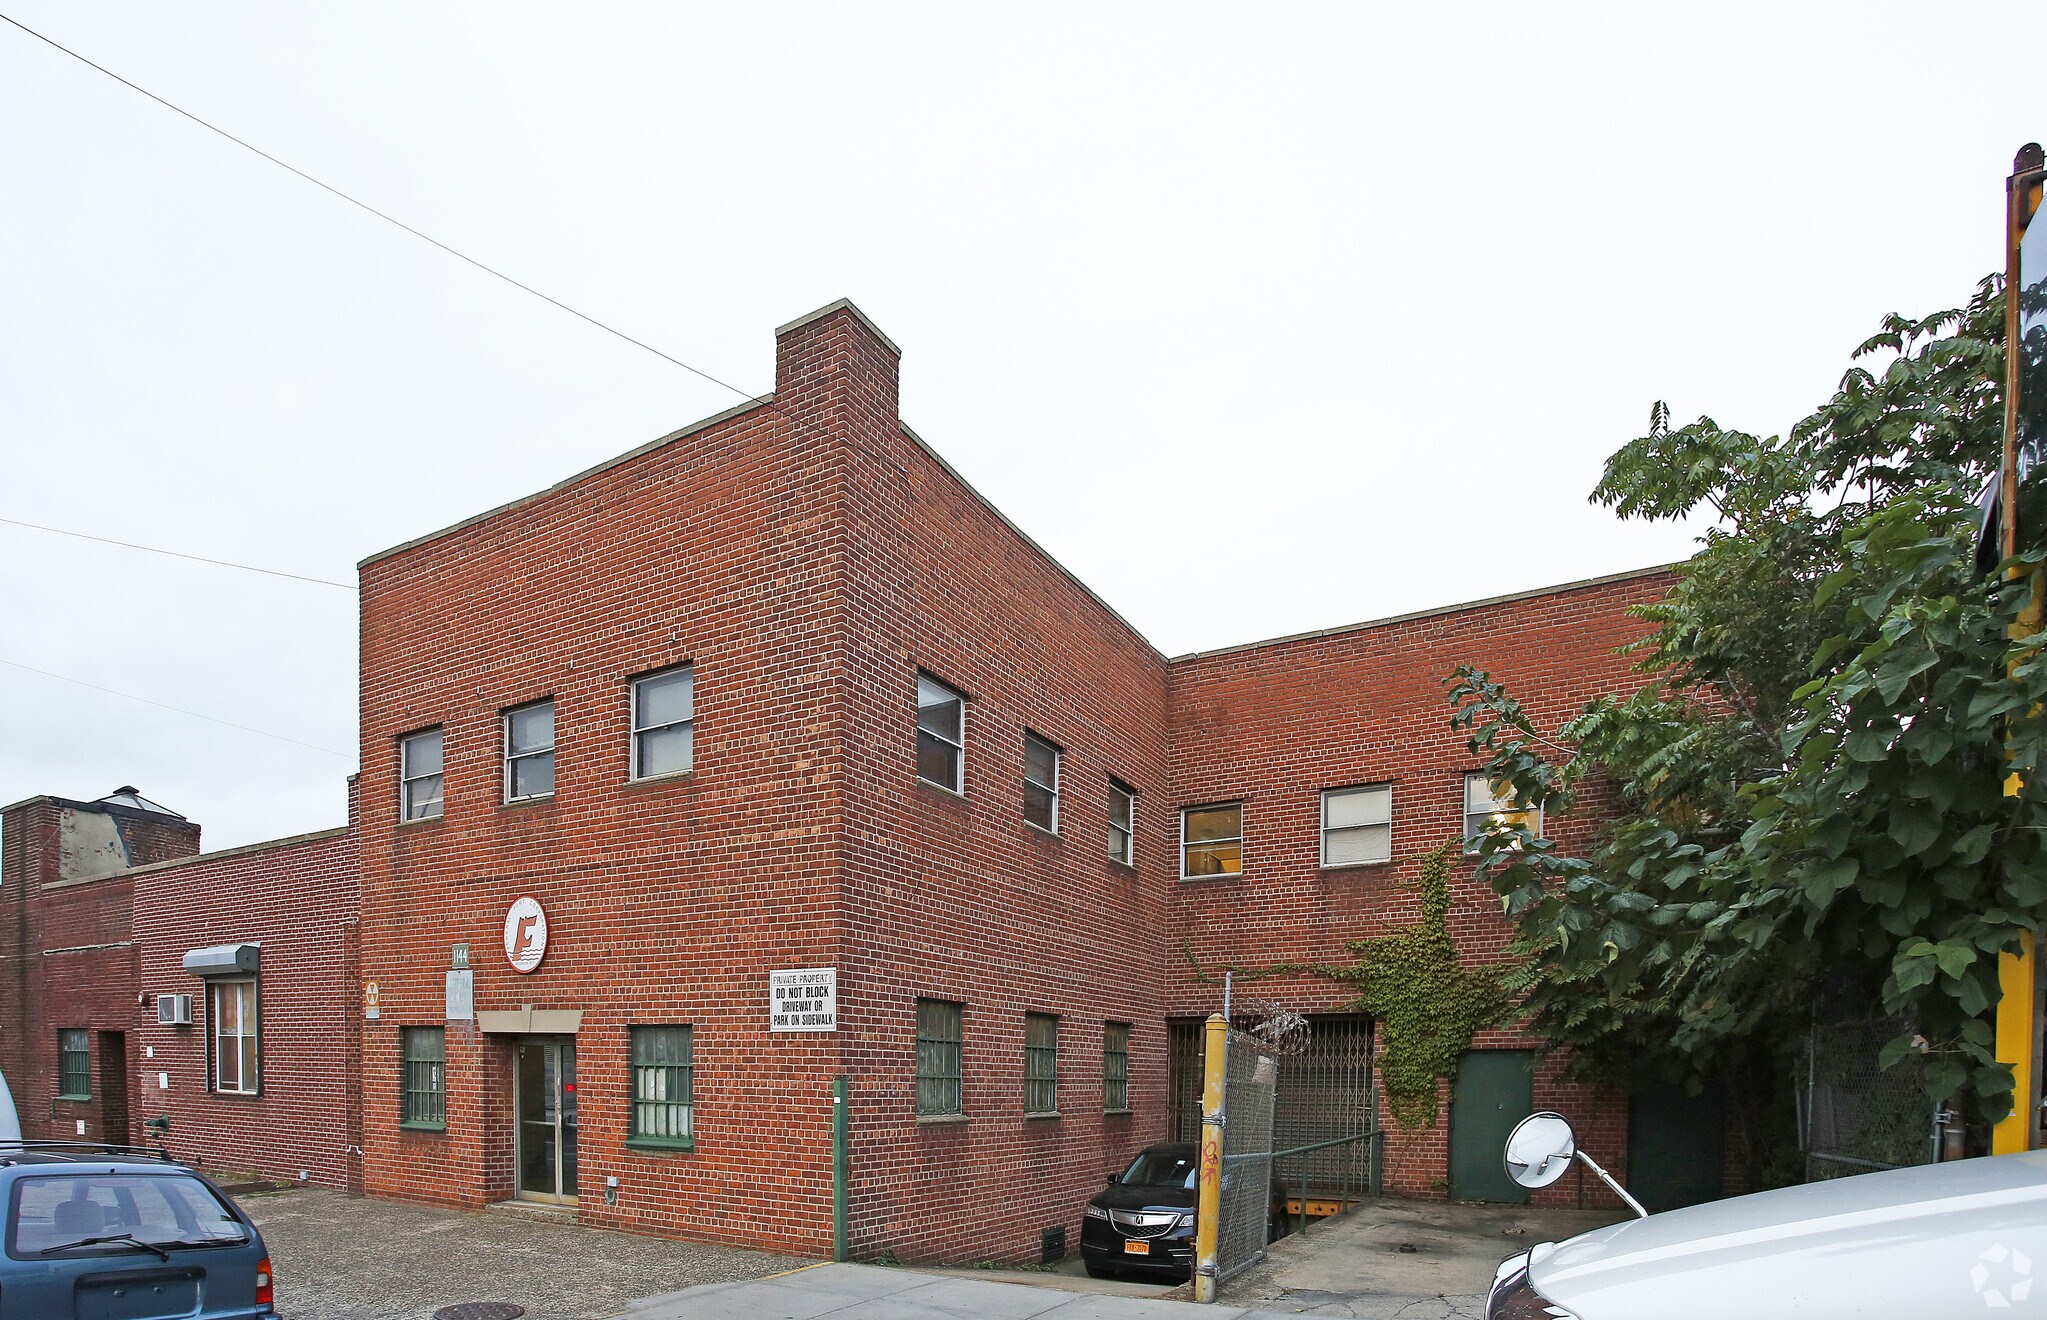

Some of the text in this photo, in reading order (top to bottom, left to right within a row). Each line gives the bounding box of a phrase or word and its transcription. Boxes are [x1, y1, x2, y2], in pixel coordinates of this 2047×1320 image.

[453, 948, 468, 963] 1144
[773, 974, 833, 984] PRIVATE PROPERTY
[776, 986, 829, 999] DO NOT BLOCK
[782, 1000, 823, 1012] DRIVEWAY OR
[773, 1014, 833, 1026] PARK ON SIDEWALK
